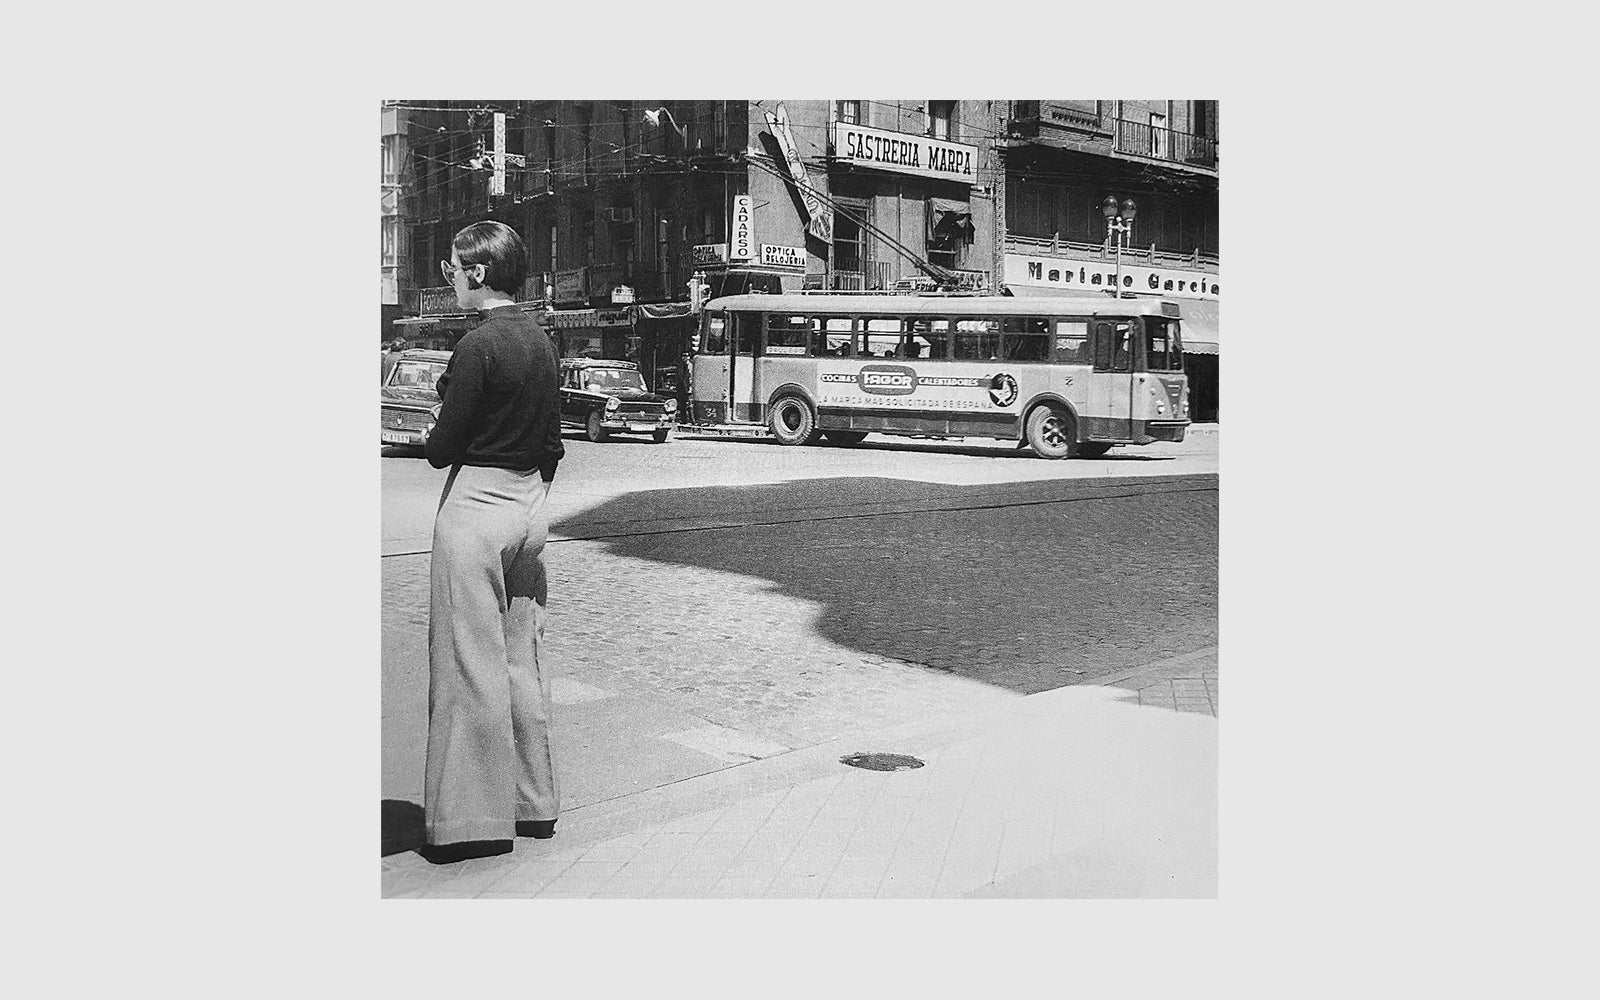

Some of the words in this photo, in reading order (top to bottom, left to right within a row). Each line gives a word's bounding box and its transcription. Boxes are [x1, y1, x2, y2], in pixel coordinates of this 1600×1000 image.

[847, 131, 920, 168] SASTRERIA
[928, 145, 972, 175] MARPA
[737, 198, 749, 257] CADARSO
[765, 246, 796, 256] OPTICA
[766, 254, 806, 266] RELOJERIA
[1028, 261, 1133, 288] Mariano
[1148, 272, 1219, 296] García
[820, 374, 858, 383] COCINAS
[863, 371, 913, 387] FAGOR
[918, 377, 979, 387] CALENTADORES
[831, 396, 863, 406] MARCA
[943, 399, 954, 408] DE
